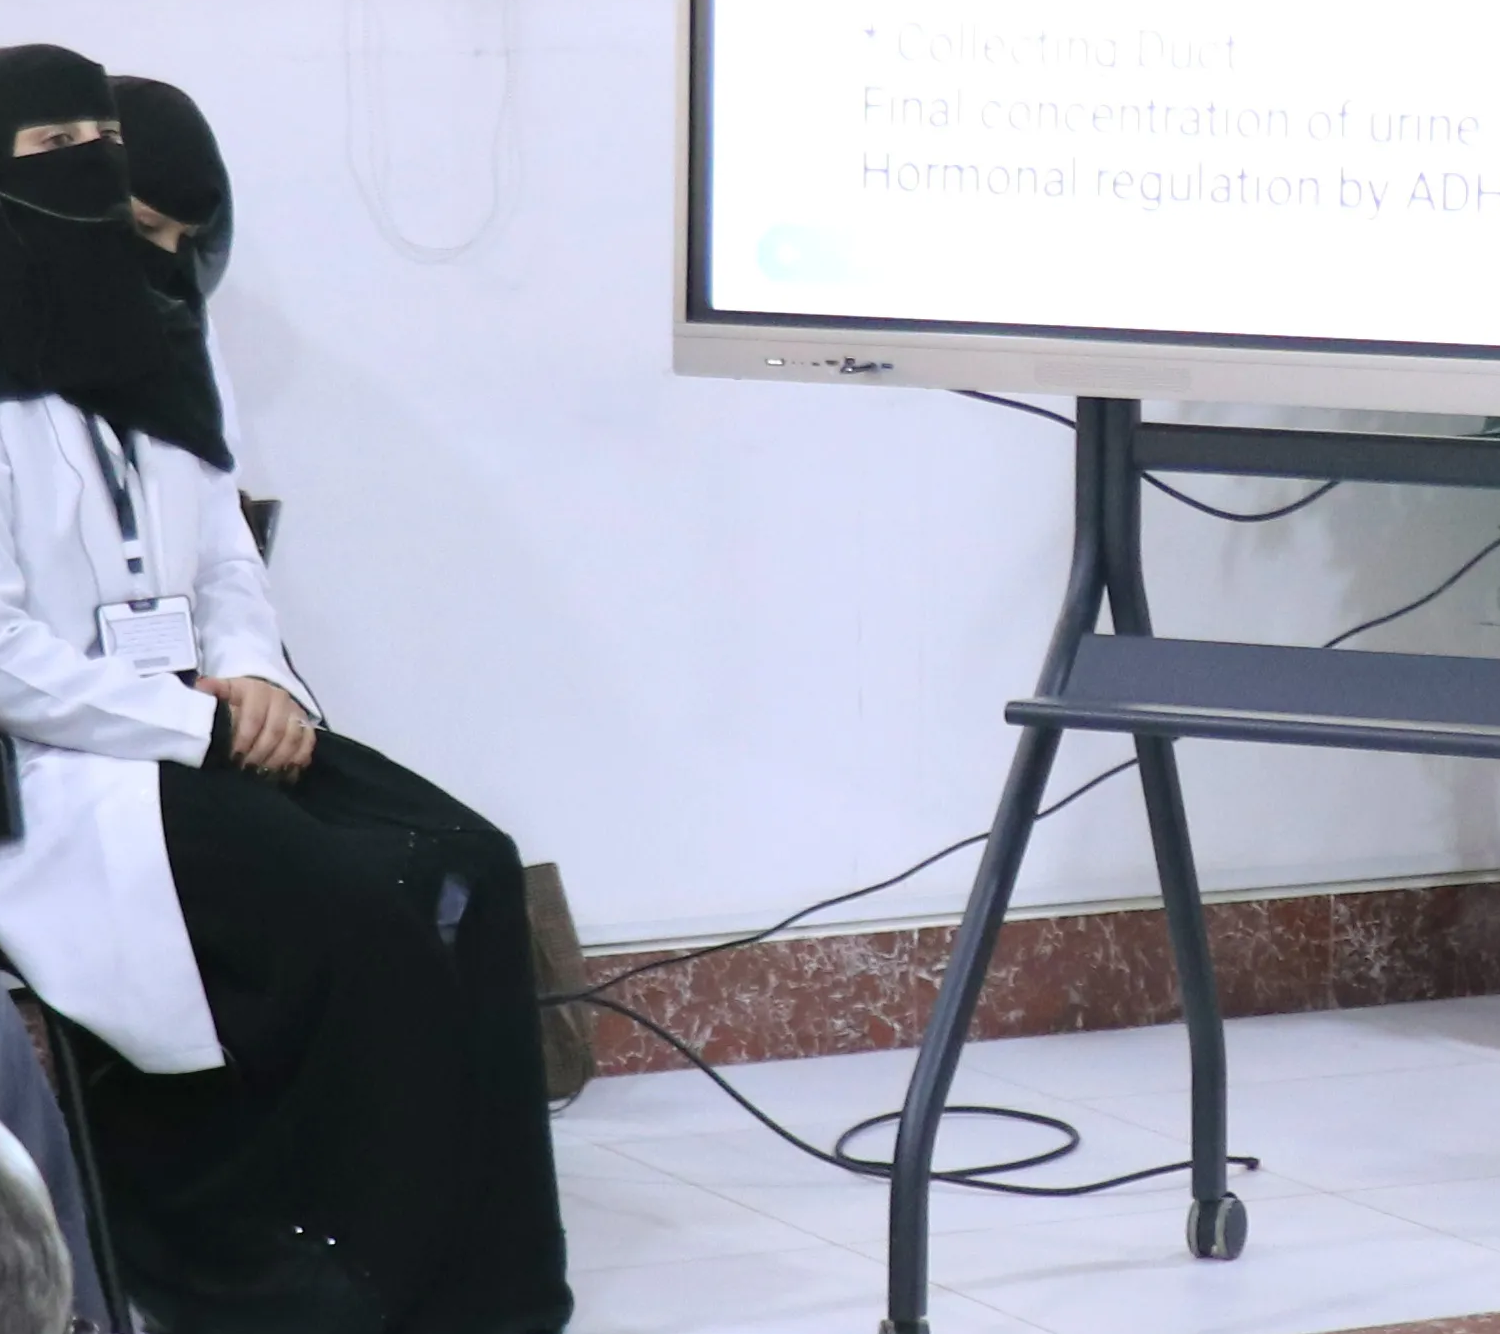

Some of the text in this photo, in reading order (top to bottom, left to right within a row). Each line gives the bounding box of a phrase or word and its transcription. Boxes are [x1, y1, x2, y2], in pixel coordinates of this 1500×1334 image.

[861, 84, 1481, 147] Final concentration of urine
[861, 151, 1078, 200] Hormonal
[1095, 162, 1323, 215] regulation
[1338, 168, 1390, 221] by
